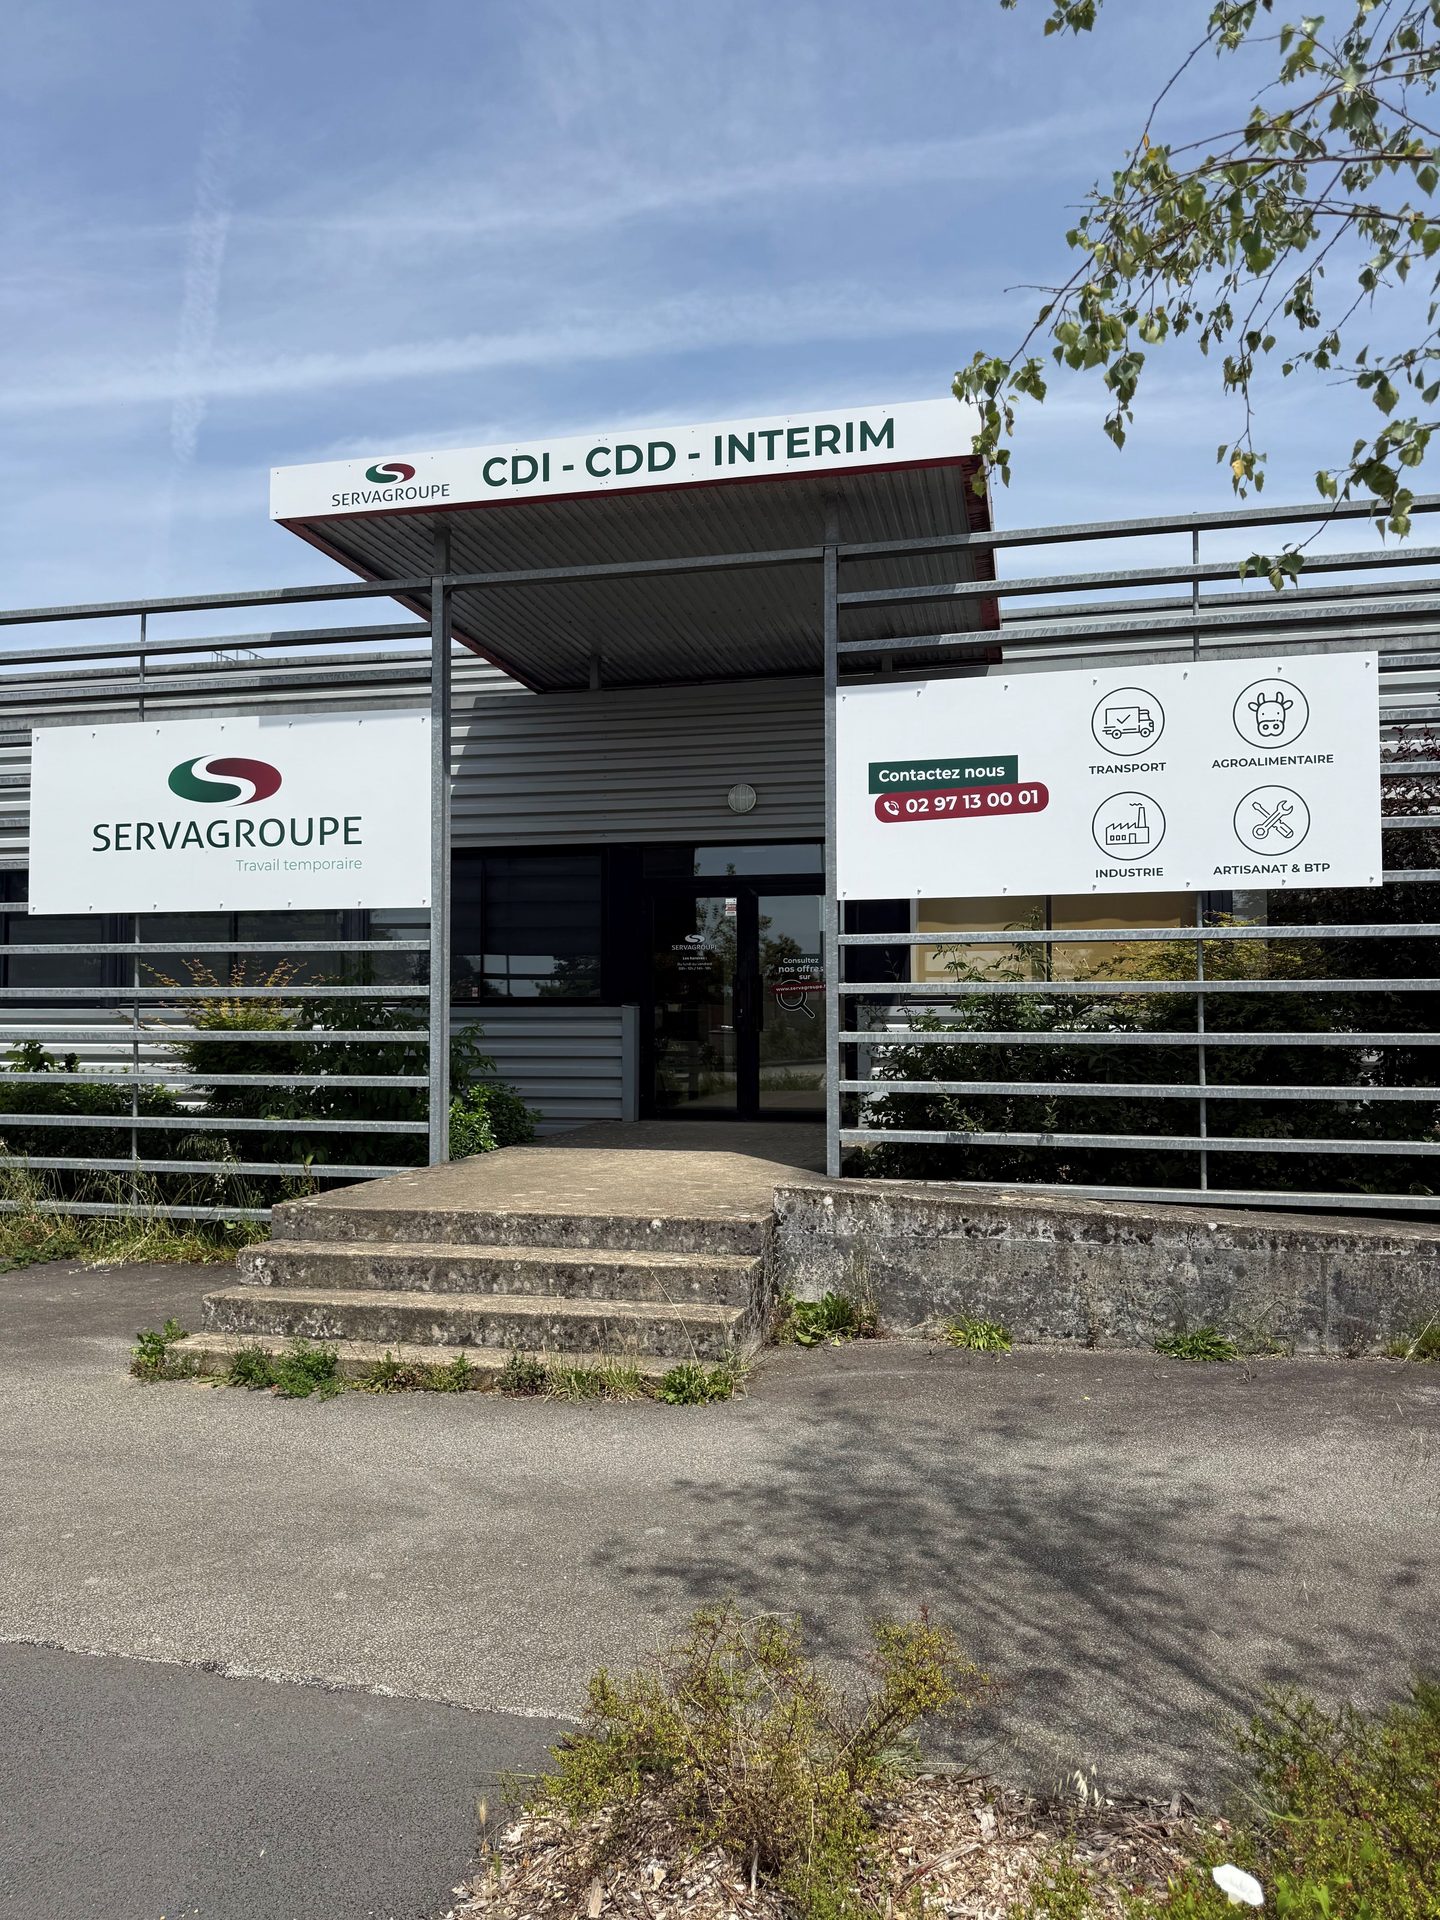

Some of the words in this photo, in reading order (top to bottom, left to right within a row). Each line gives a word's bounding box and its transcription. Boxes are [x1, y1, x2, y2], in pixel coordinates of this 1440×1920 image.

[482, 452, 550, 487] CDI
[585, 441, 677, 478] CDD
[714, 417, 895, 467] INTERIM
[331, 483, 450, 507] SERVAGROUPE
[1088, 761, 1167, 775] TRANSPORT
[1211, 753, 1334, 769] AGROALIMENTAIRE
[878, 767, 961, 783] Contactez
[964, 766, 1006, 779] nous
[905, 797, 930, 813] 02
[933, 795, 958, 812] 97
[962, 793, 982, 809] 13
[986, 791, 1013, 808] 00
[1018, 789, 1038, 805] 01
[92, 816, 363, 852] SERVAGROUPE
[235, 858, 280, 872] Travail
[283, 857, 363, 873] temporaire
[1095, 867, 1164, 879] INDUSTRIE
[1212, 863, 1289, 876] ARTISANAT
[1291, 863, 1301, 873] &
[1304, 862, 1331, 873] BTP
[796, 965, 824, 973] offres
